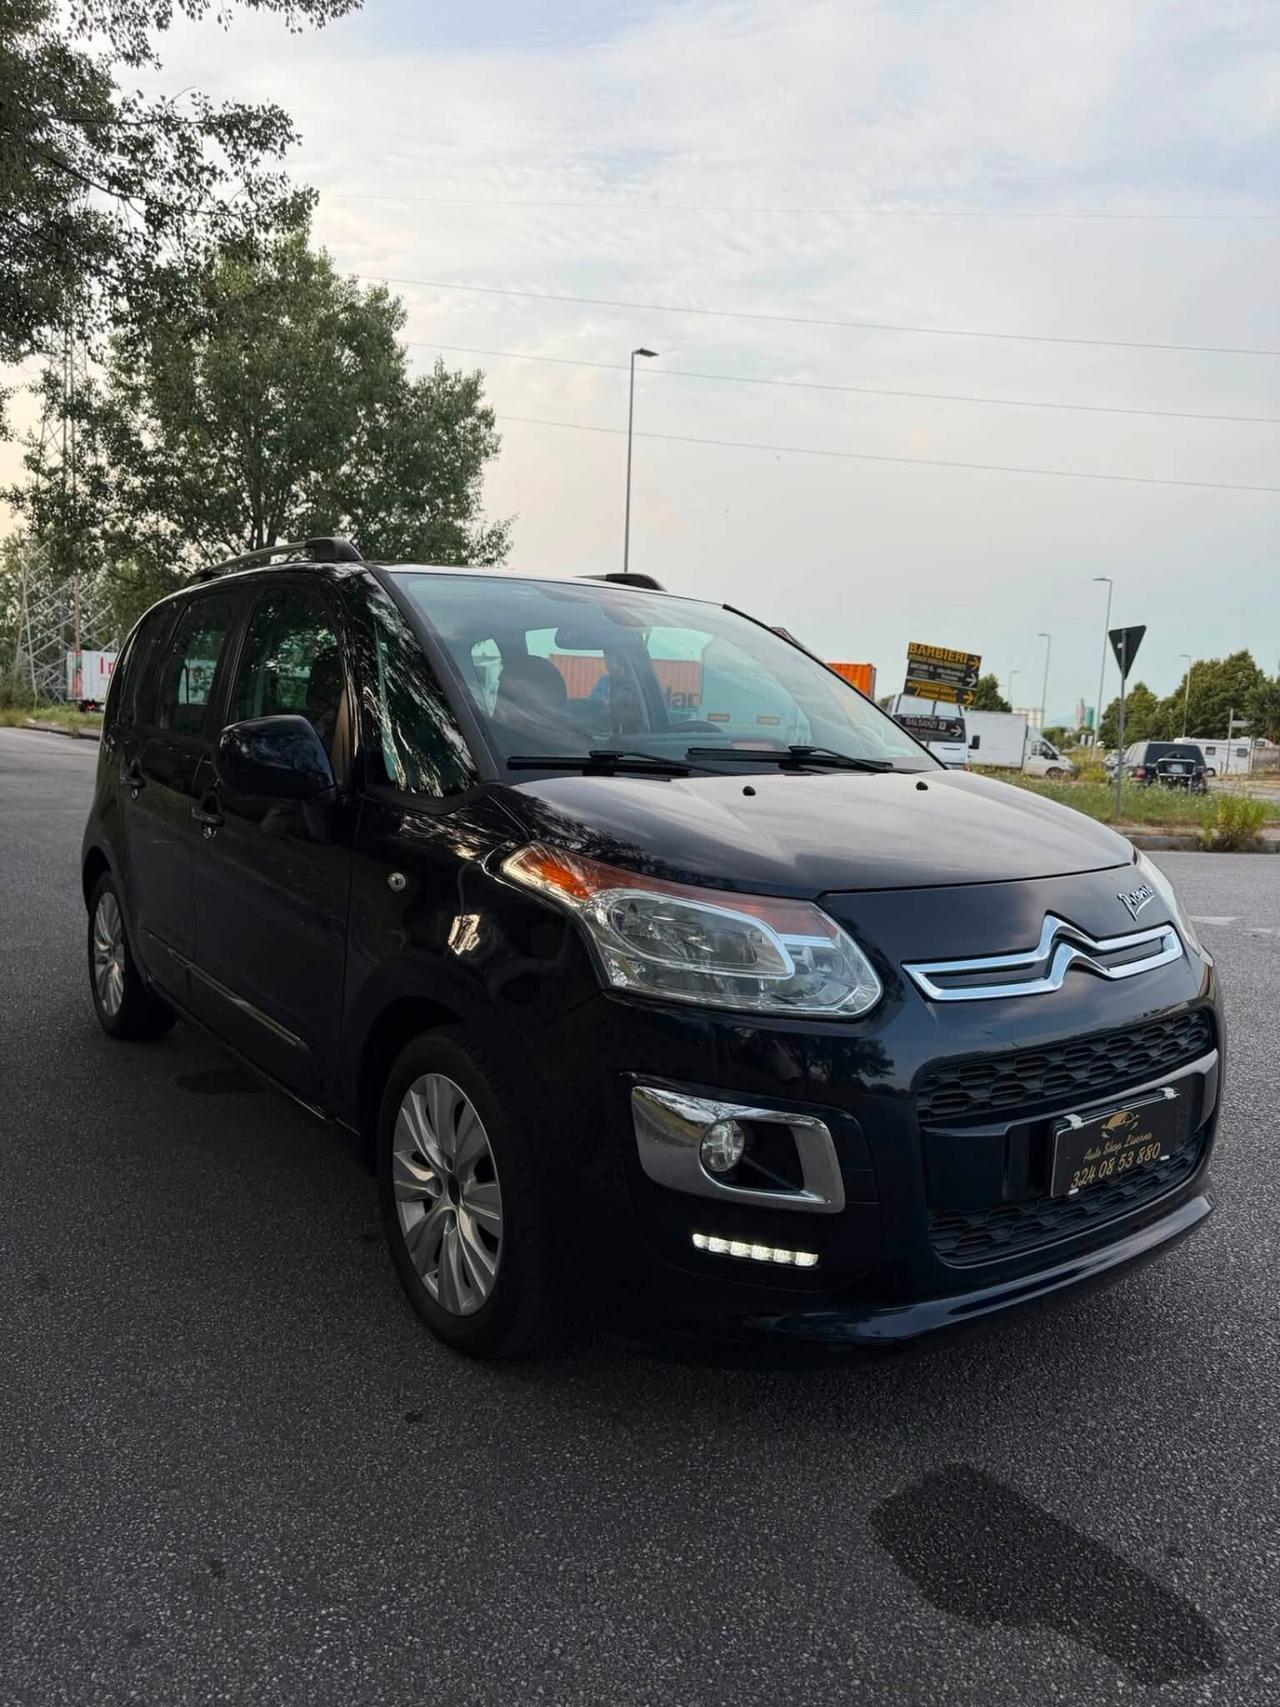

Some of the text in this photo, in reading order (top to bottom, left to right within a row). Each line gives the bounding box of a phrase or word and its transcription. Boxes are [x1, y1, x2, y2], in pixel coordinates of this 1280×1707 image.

[909, 643, 968, 664] BARBIERI
[1083, 1146, 1102, 1163] Auto
[1103, 1139, 1122, 1156] Shop
[1070, 1142, 1161, 1189] 324 08 53 880
